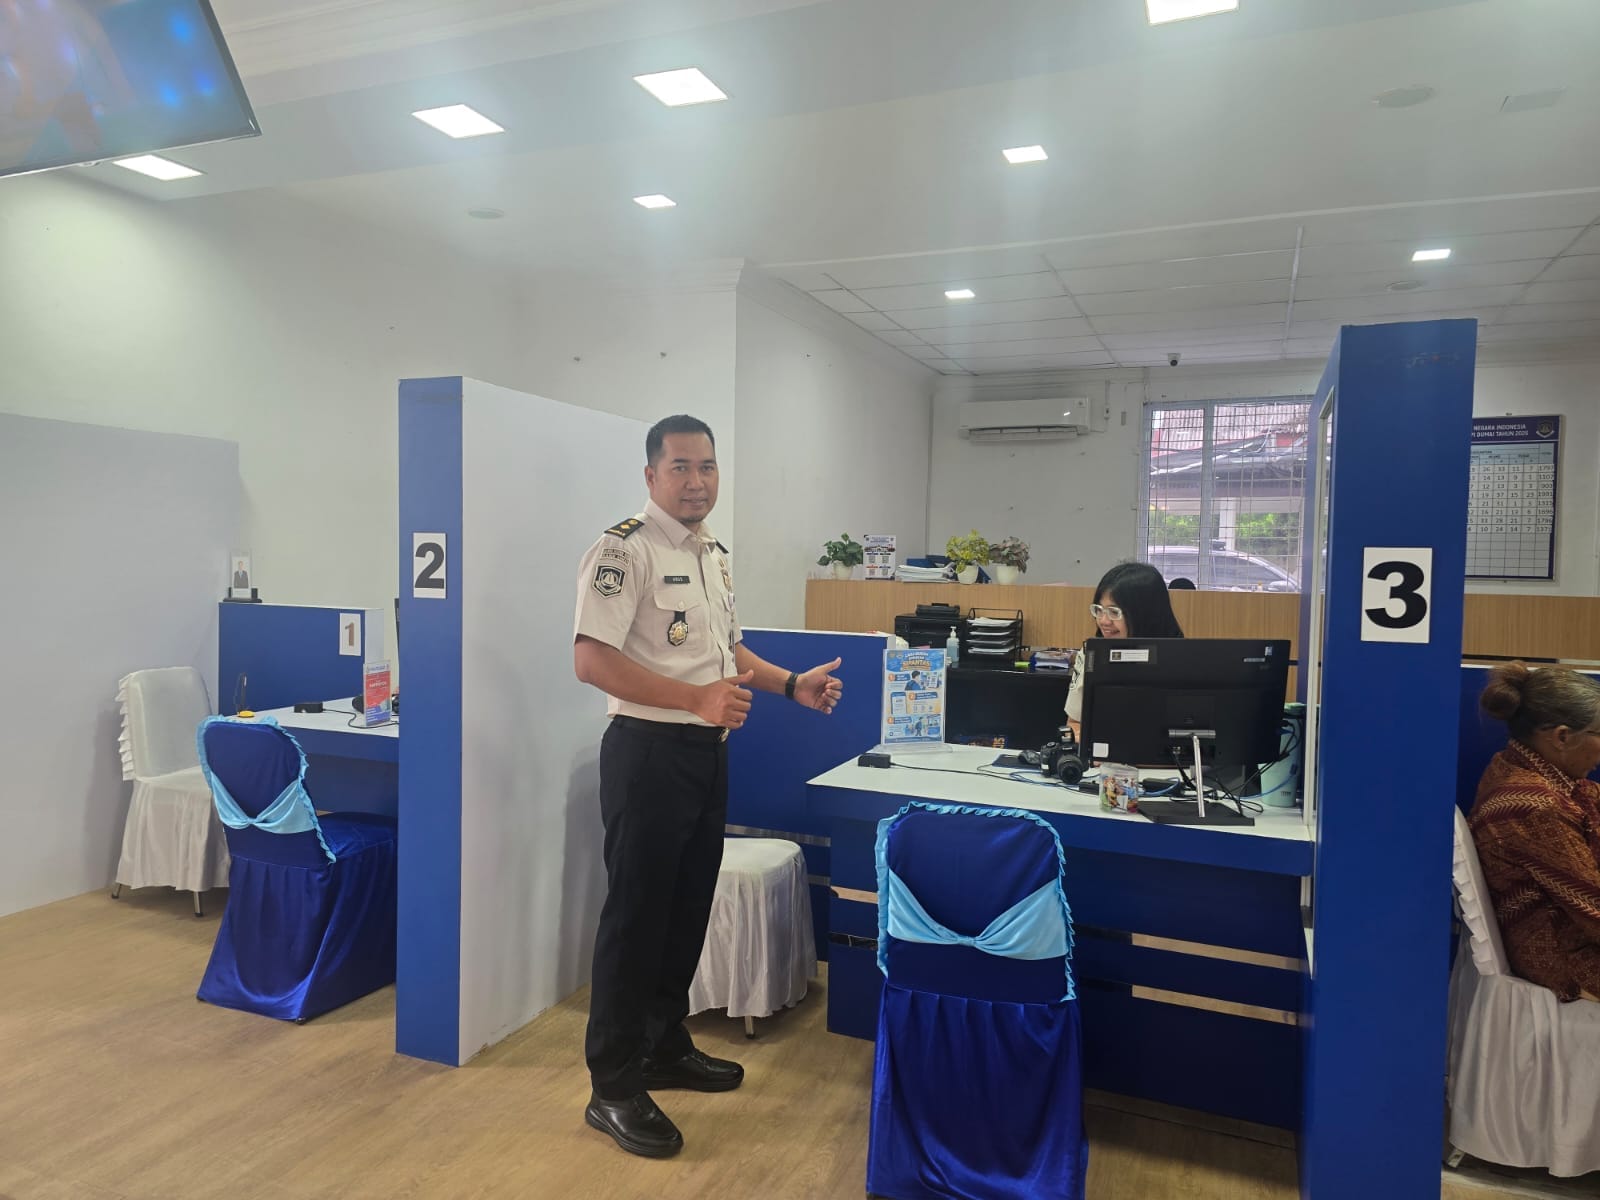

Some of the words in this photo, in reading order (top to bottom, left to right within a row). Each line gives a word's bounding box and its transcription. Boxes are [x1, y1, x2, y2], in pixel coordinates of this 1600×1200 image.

[414, 542, 445, 589] 2
[1365, 560, 1427, 629] 3
[344, 622, 355, 646] 1
